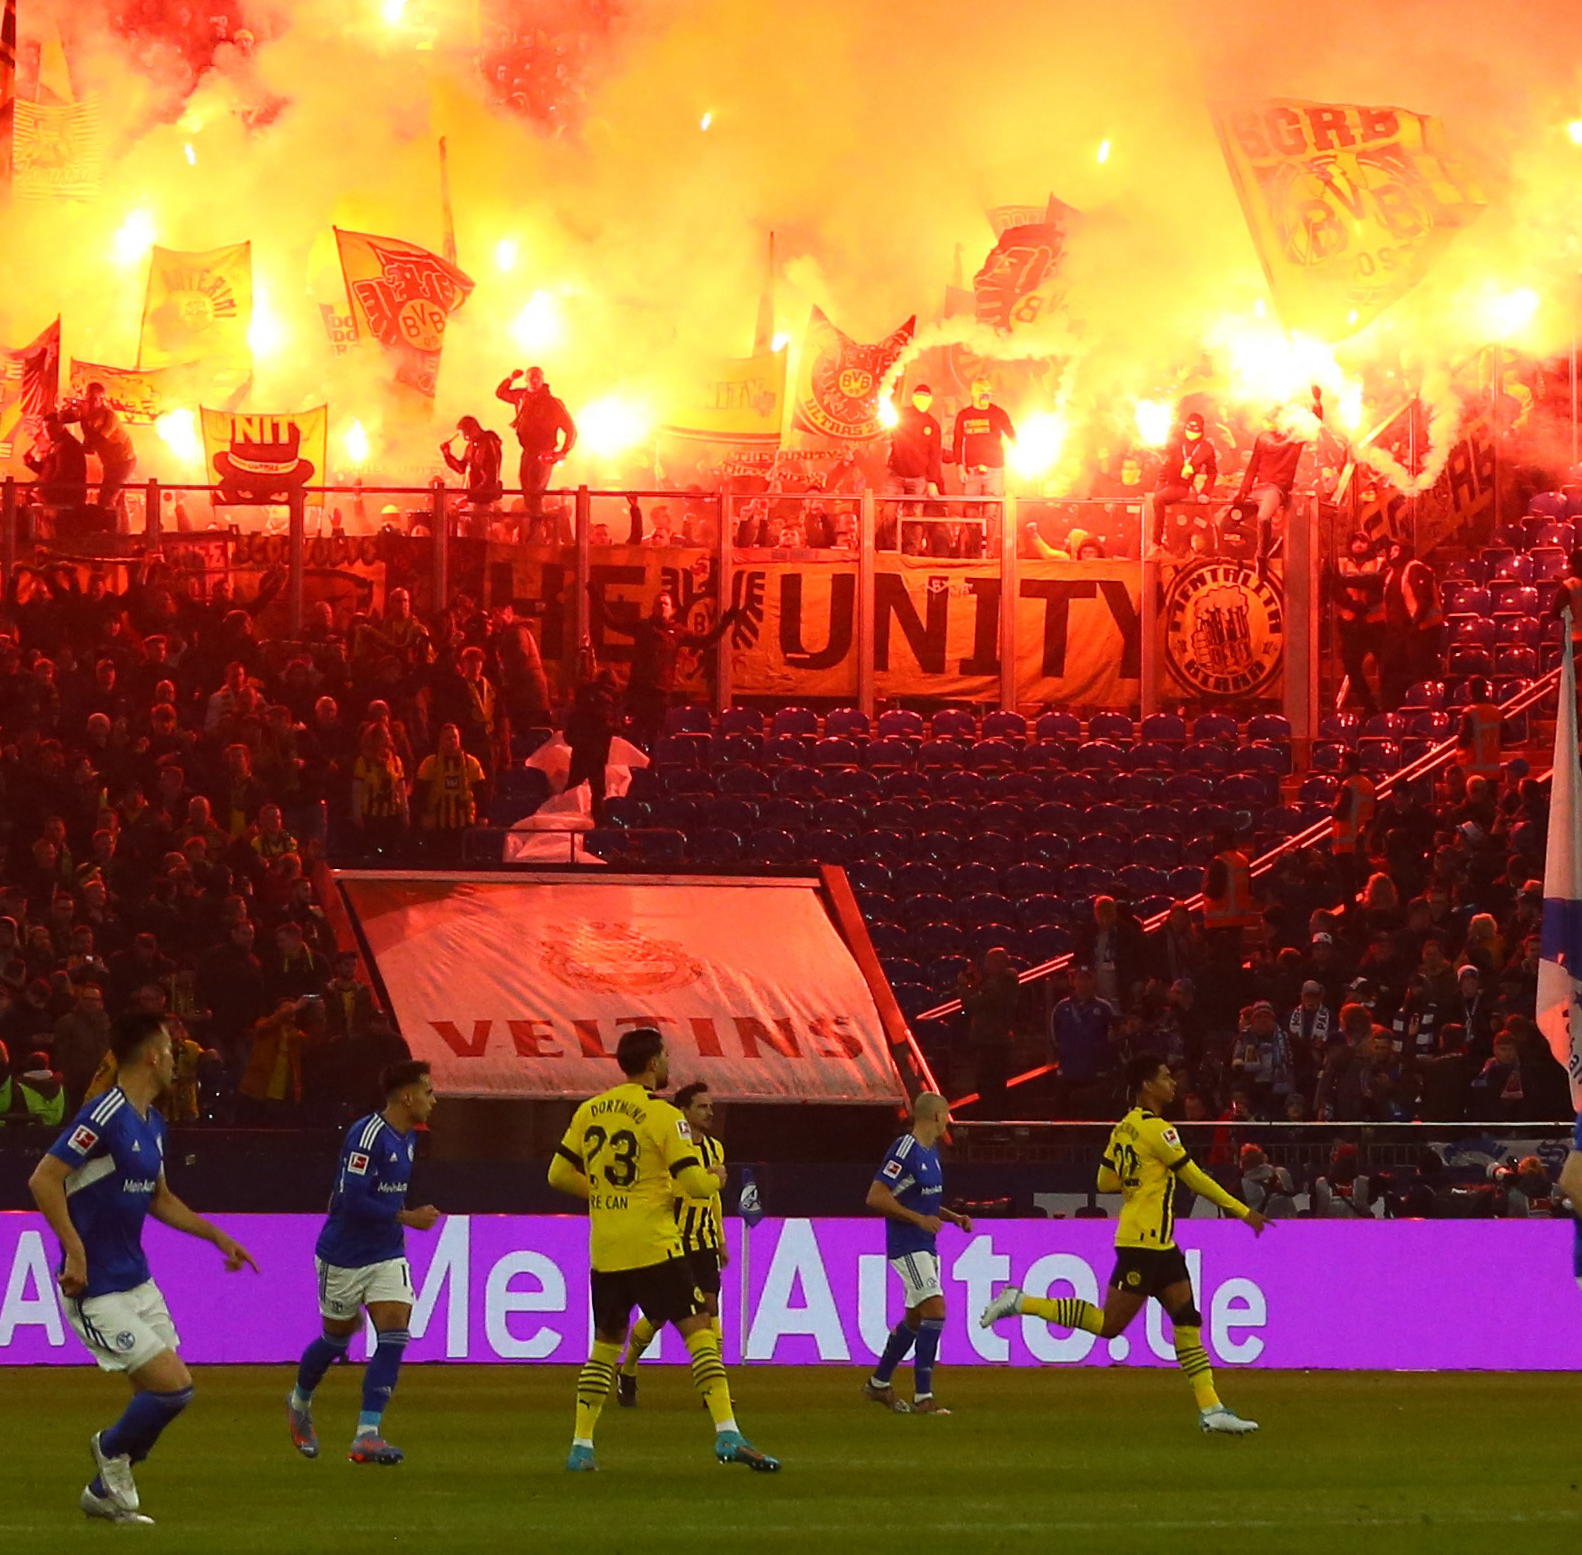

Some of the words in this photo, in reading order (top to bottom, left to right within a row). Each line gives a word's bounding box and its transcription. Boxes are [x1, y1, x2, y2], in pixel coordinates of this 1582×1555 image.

[402, 302, 446, 339] BVB
[842, 372, 871, 390] BVB
[213, 415, 312, 445] UNITY
[779, 571, 1141, 681] UNITY
[590, 1098, 648, 1126] DORTMUND
[582, 1124, 641, 1190] 23
[606, 1194, 629, 1210] CAN
